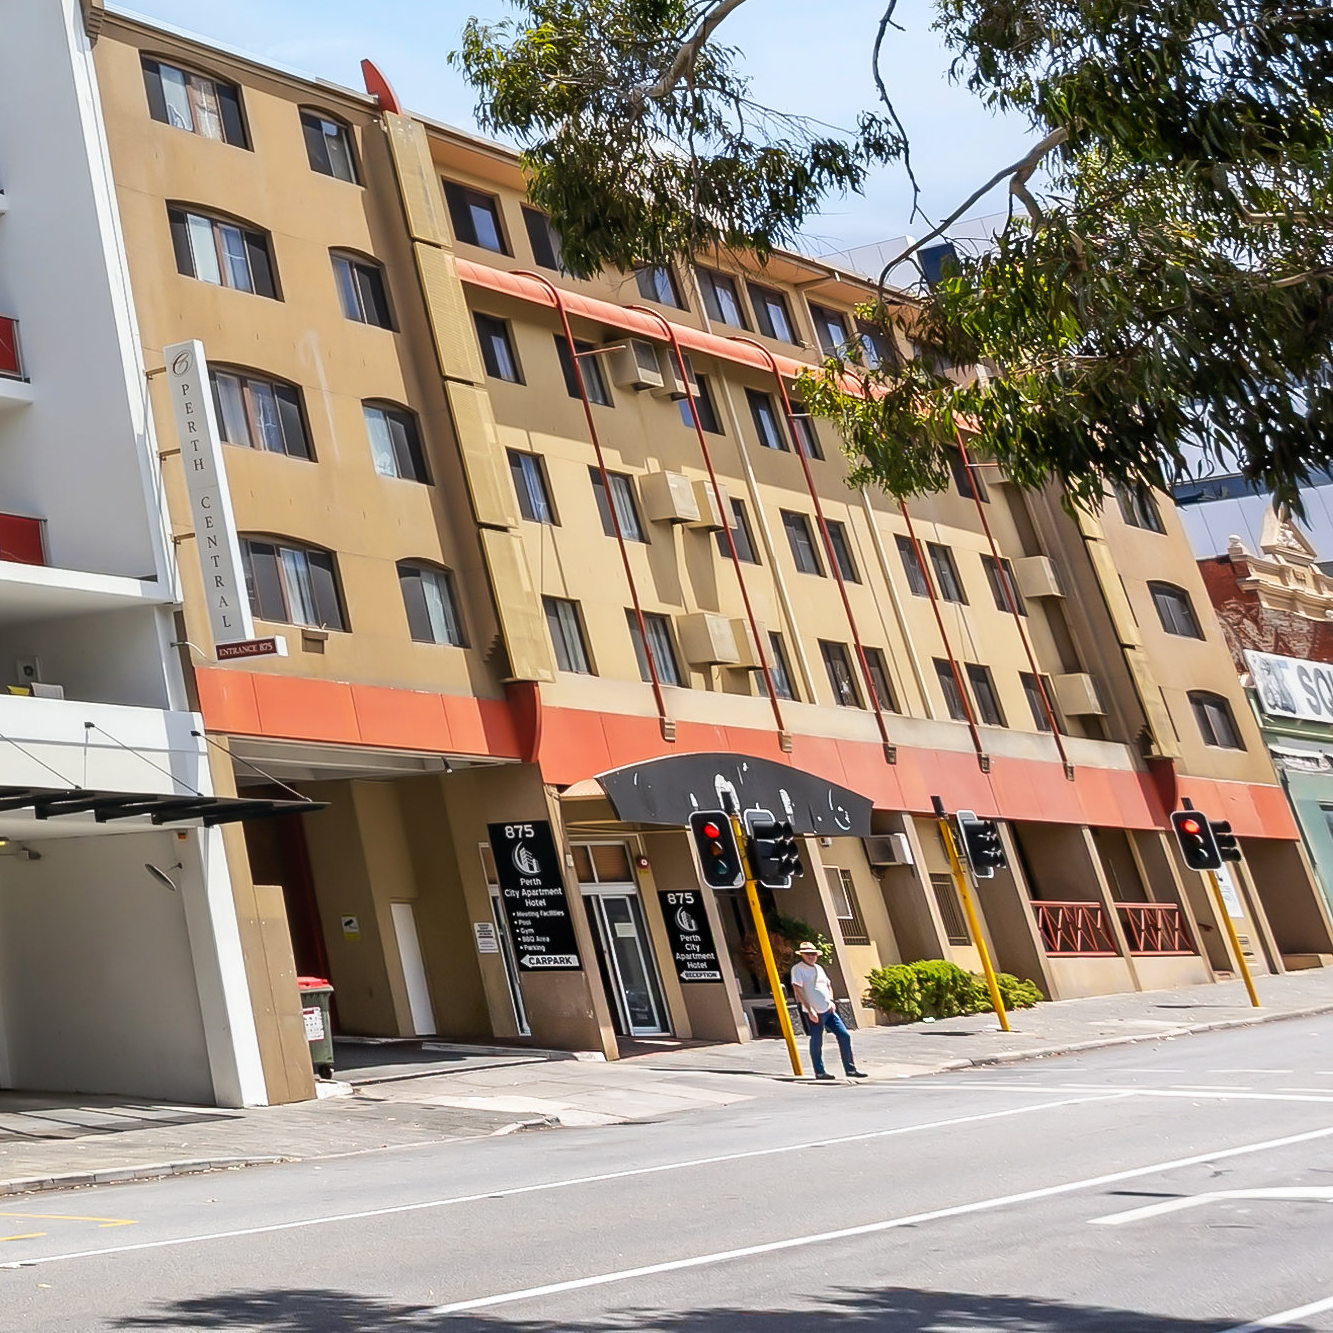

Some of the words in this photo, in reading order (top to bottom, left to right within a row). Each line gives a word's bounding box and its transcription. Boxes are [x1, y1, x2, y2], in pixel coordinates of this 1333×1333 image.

[181, 383, 205, 471] PERTH
[200, 495, 232, 628] CENTRAL
[218, 644, 258, 656] ENTRANCE
[259, 642, 273, 652] 875
[1296, 664, 1333, 717] SQ
[504, 824, 535, 839] 875
[519, 877, 542, 886] Perth
[504, 888, 519, 899] City
[521, 887, 563, 898] Apartment
[524, 898, 547, 907] Hotel
[667, 892, 695, 904] 875
[679, 934, 702, 942] Perth
[684, 943, 700, 952] City
[528, 956, 573, 965] CARPARK
[675, 952, 716, 961] Apartment
[686, 961, 708, 969] Hotel
